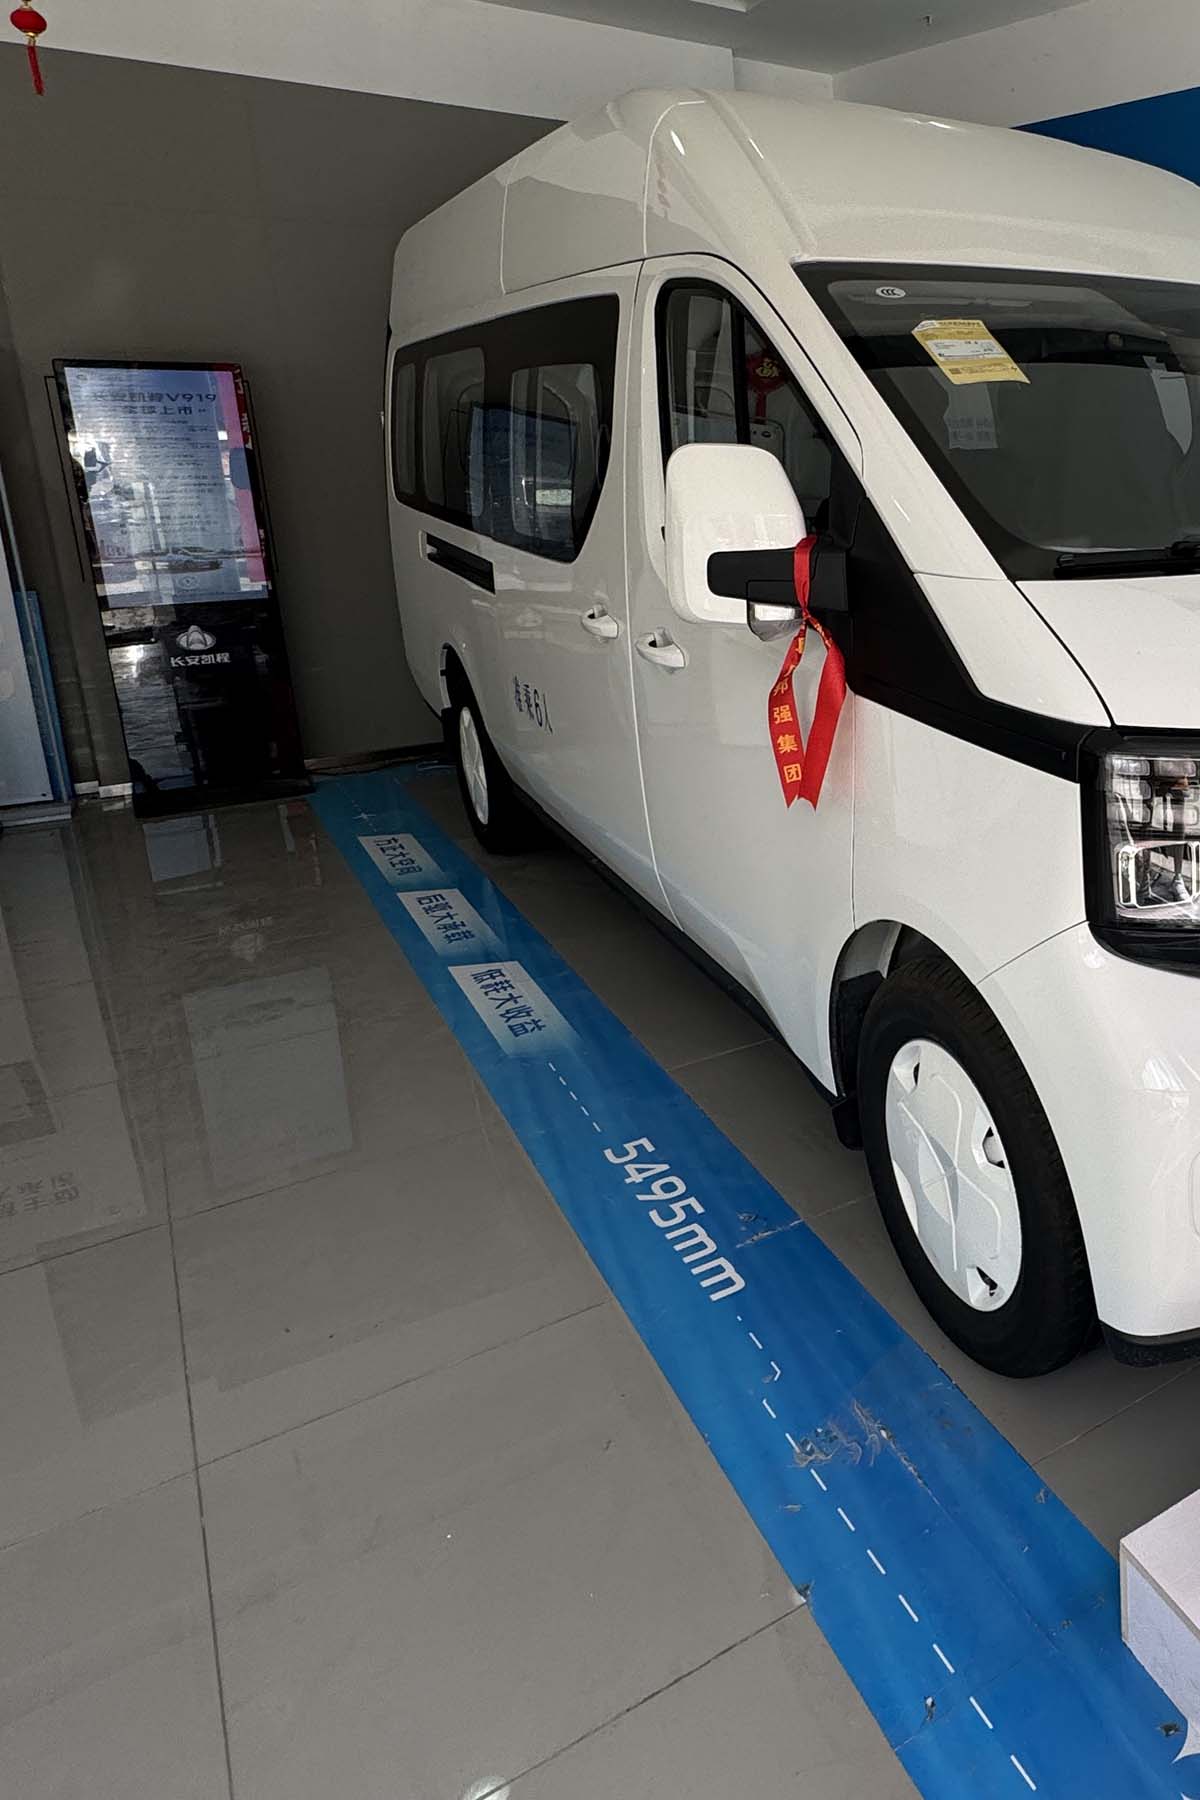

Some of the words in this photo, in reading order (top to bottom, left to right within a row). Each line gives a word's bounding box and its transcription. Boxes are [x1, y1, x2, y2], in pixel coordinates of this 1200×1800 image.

[170, 653, 232, 667] 长安凯程
[470, 968, 547, 1038] 低耗大收益
[603, 1137, 746, 1302] 5495mm
